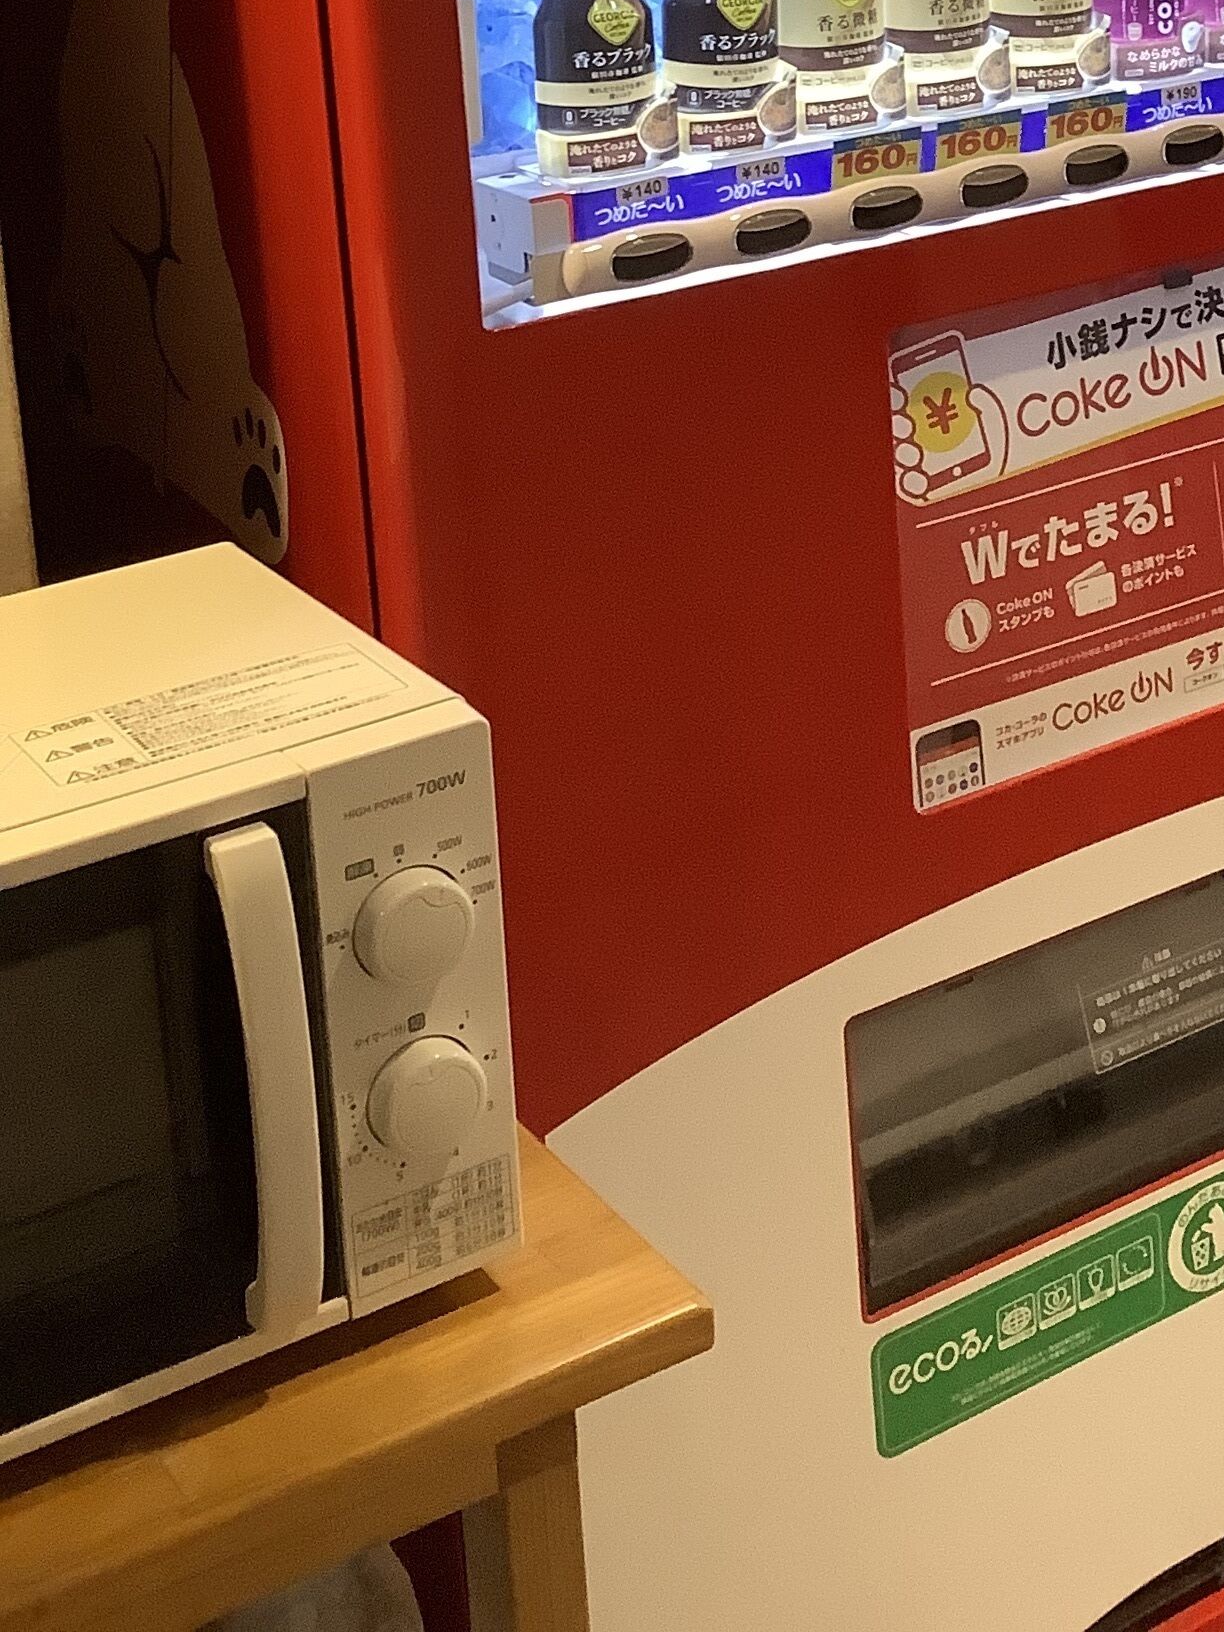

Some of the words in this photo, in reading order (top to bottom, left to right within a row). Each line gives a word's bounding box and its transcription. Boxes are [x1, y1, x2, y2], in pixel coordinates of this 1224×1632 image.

[700, 29, 776, 51] 香るブラック
[573, 43, 651, 68] 香るブラック
[1127, 47, 1181, 63] なめらかな
[1166, 87, 1197, 100] ¥190
[715, 99, 748, 109] コーヒー
[806, 98, 869, 116] 淹れたてのような
[593, 117, 626, 127] コーヒー
[691, 121, 758, 135] 淹れたてのような
[828, 112, 869, 126] 香りとコク
[1051, 106, 1124, 138] 160円
[569, 139, 638, 156] 淹れたてのような
[713, 132, 755, 148] 香りとコク
[941, 126, 1018, 159] 160円
[593, 151, 637, 167] 香りとコク
[837, 144, 919, 177] 160円
[741, 162, 780, 179] ¥140
[622, 180, 662, 200] ¥140
[1017, 372, 1132, 437] Coke
[1139, 340, 1207, 396] ON
[960, 482, 1174, 586] Wでたまる!
[1120, 544, 1197, 577] 各決済サービス
[1121, 565, 1185, 593] のポイントも
[996, 595, 1031, 615] Coke
[1032, 588, 1053, 604] ON
[998, 606, 1055, 633] スタンプも
[1052, 687, 1126, 732] Coke
[1130, 667, 1175, 704] ON
[995, 712, 1047, 736] コカ・コーラの
[373, 791, 414, 813] POWER
[416, 769, 466, 798] 700W
[471, 879, 496, 896] 700W
[491, 1049, 498, 1060] 2
[341, 1092, 355, 1105] 15
[486, 1099, 494, 1111] 3
[347, 1153, 362, 1166] 10
